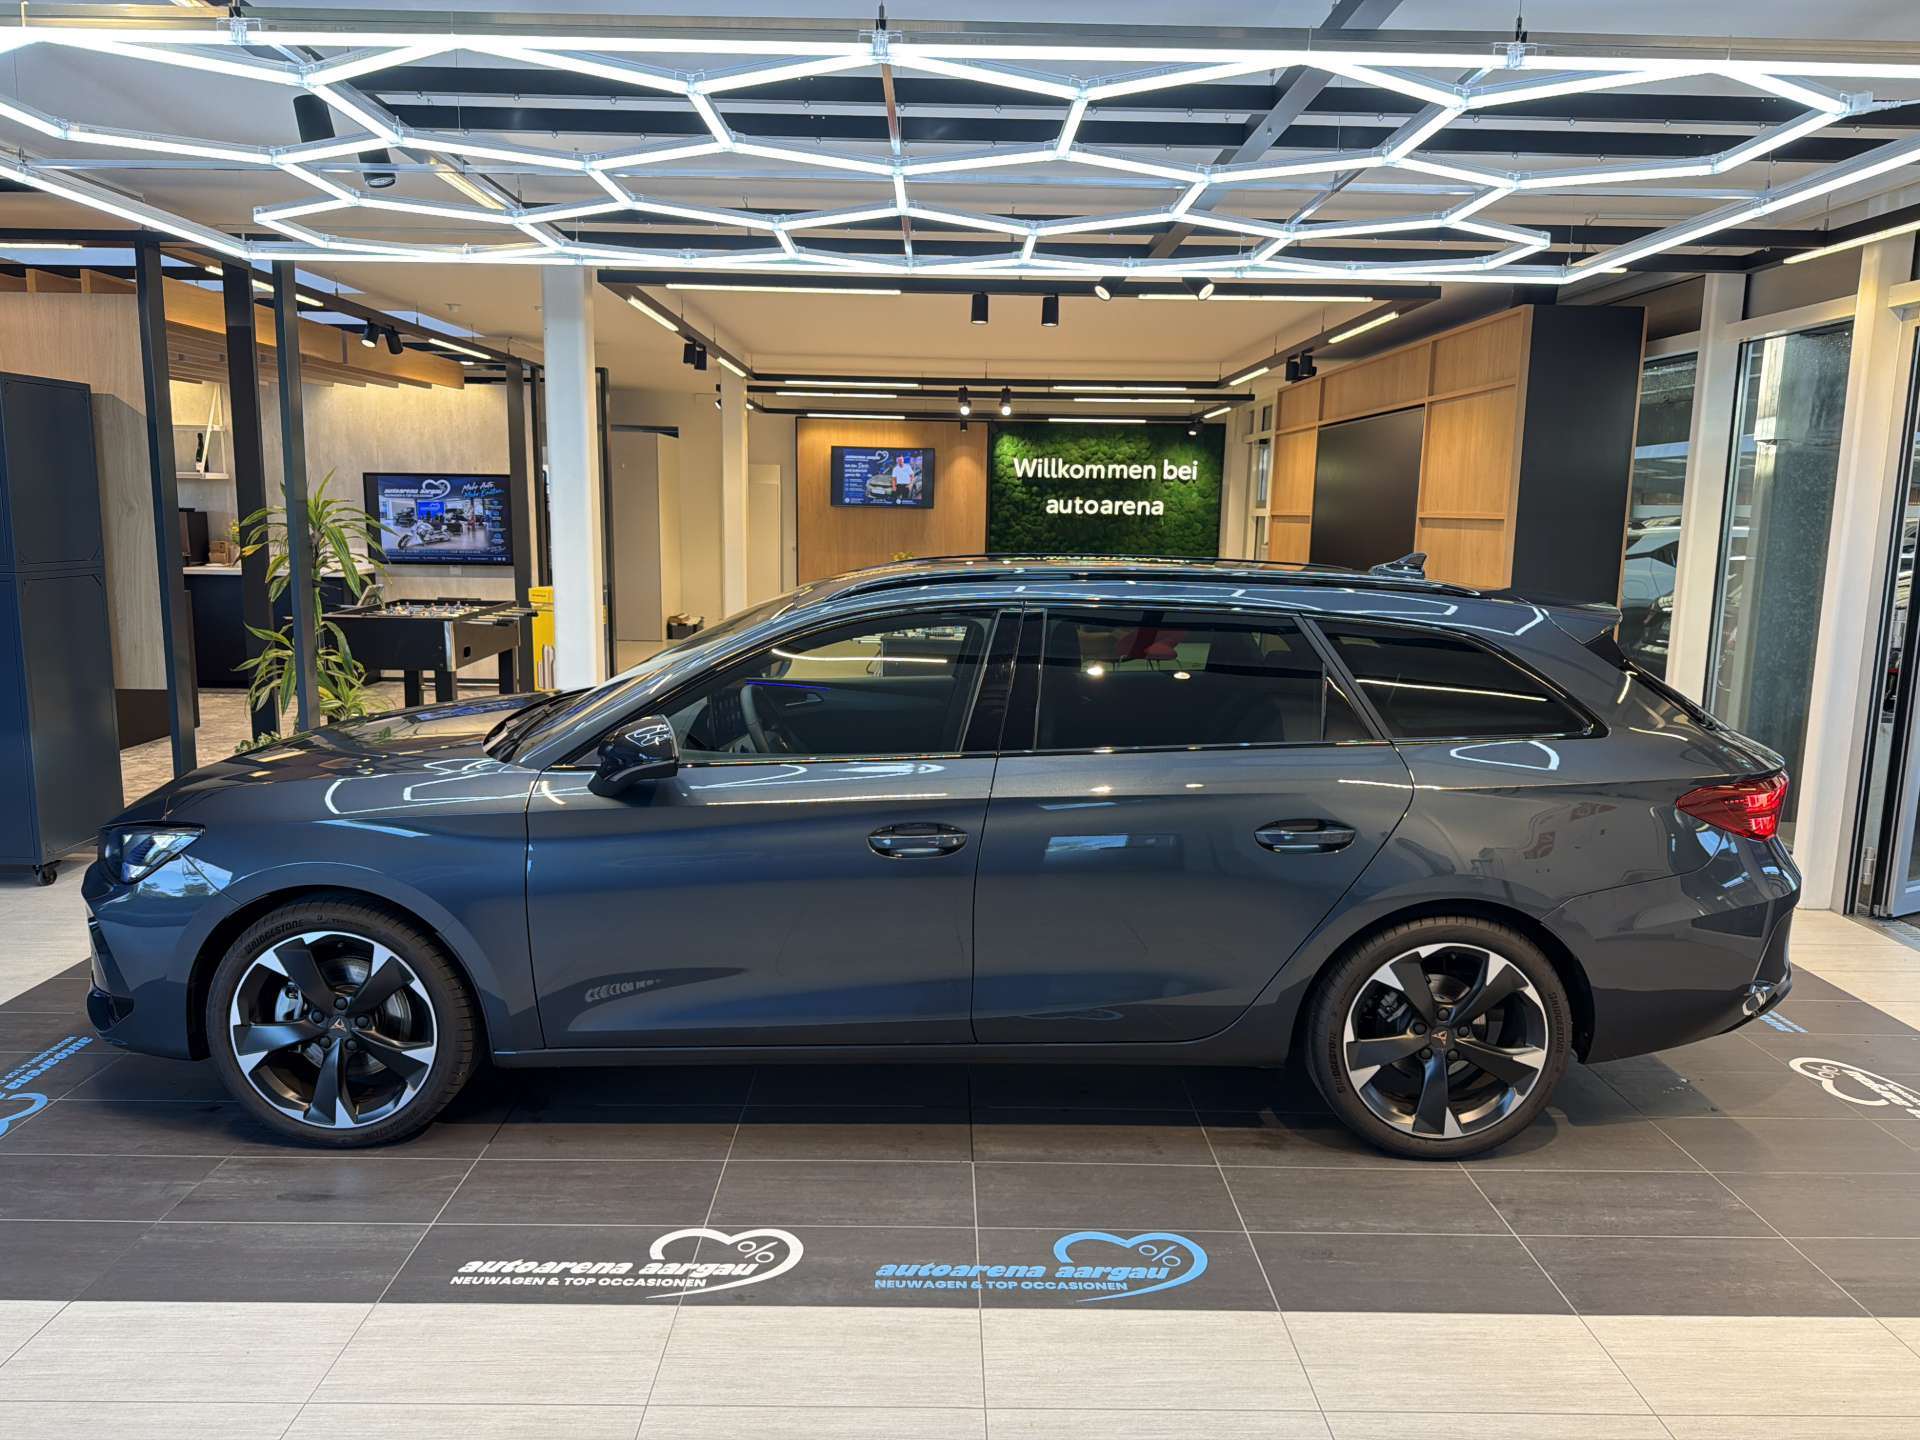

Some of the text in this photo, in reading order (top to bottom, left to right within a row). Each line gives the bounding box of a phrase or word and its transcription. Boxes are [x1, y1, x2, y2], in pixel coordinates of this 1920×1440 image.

[1013, 457, 1199, 481] Willkommen bei
[1046, 496, 1165, 516] autoarena
[458, 1258, 760, 1277] autoarena aargau
[875, 1262, 1171, 1281] autoarena aargau
[449, 1276, 708, 1289] NEUWAGEN & TOP OCCASIONEN
[873, 1278, 1129, 1292] NEUWAGEN & TOP OCCASIONEN
